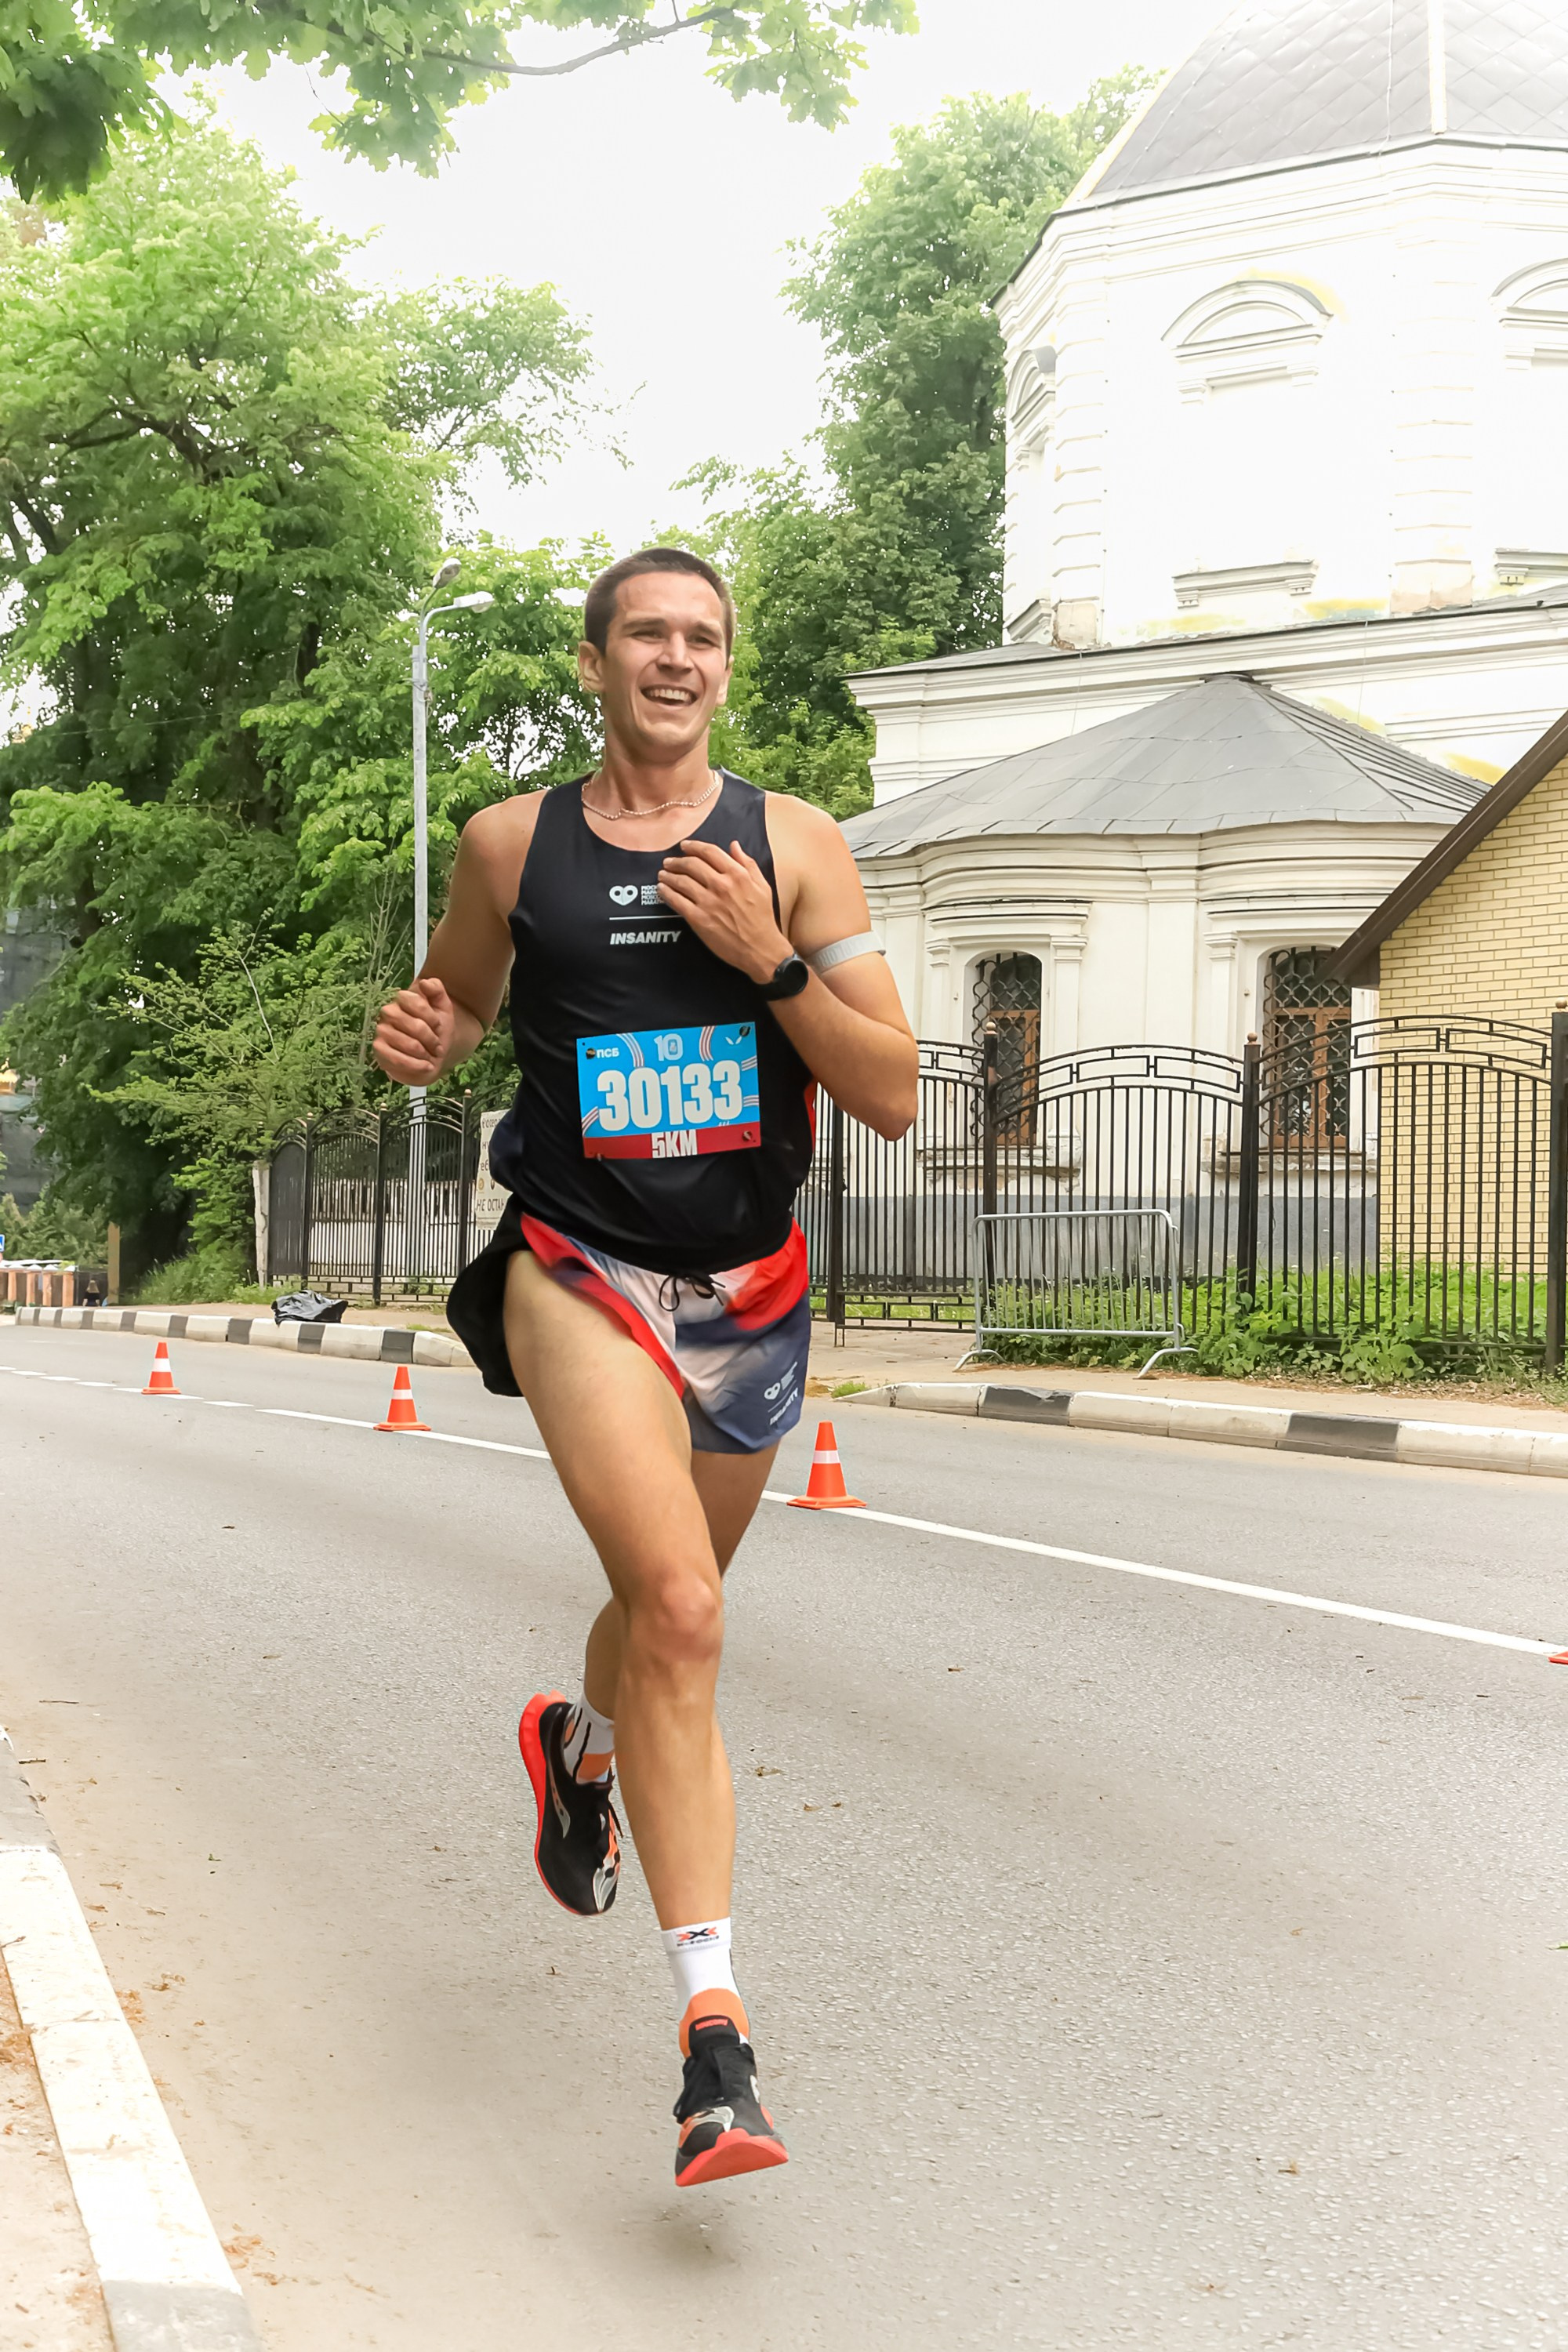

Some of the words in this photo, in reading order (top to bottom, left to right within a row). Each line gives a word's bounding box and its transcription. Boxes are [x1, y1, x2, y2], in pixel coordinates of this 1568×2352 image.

[610, 931, 681, 945] INSANITY
[596, 1047, 619, 1058] ПСБ
[597, 1060, 742, 1131] 30133
